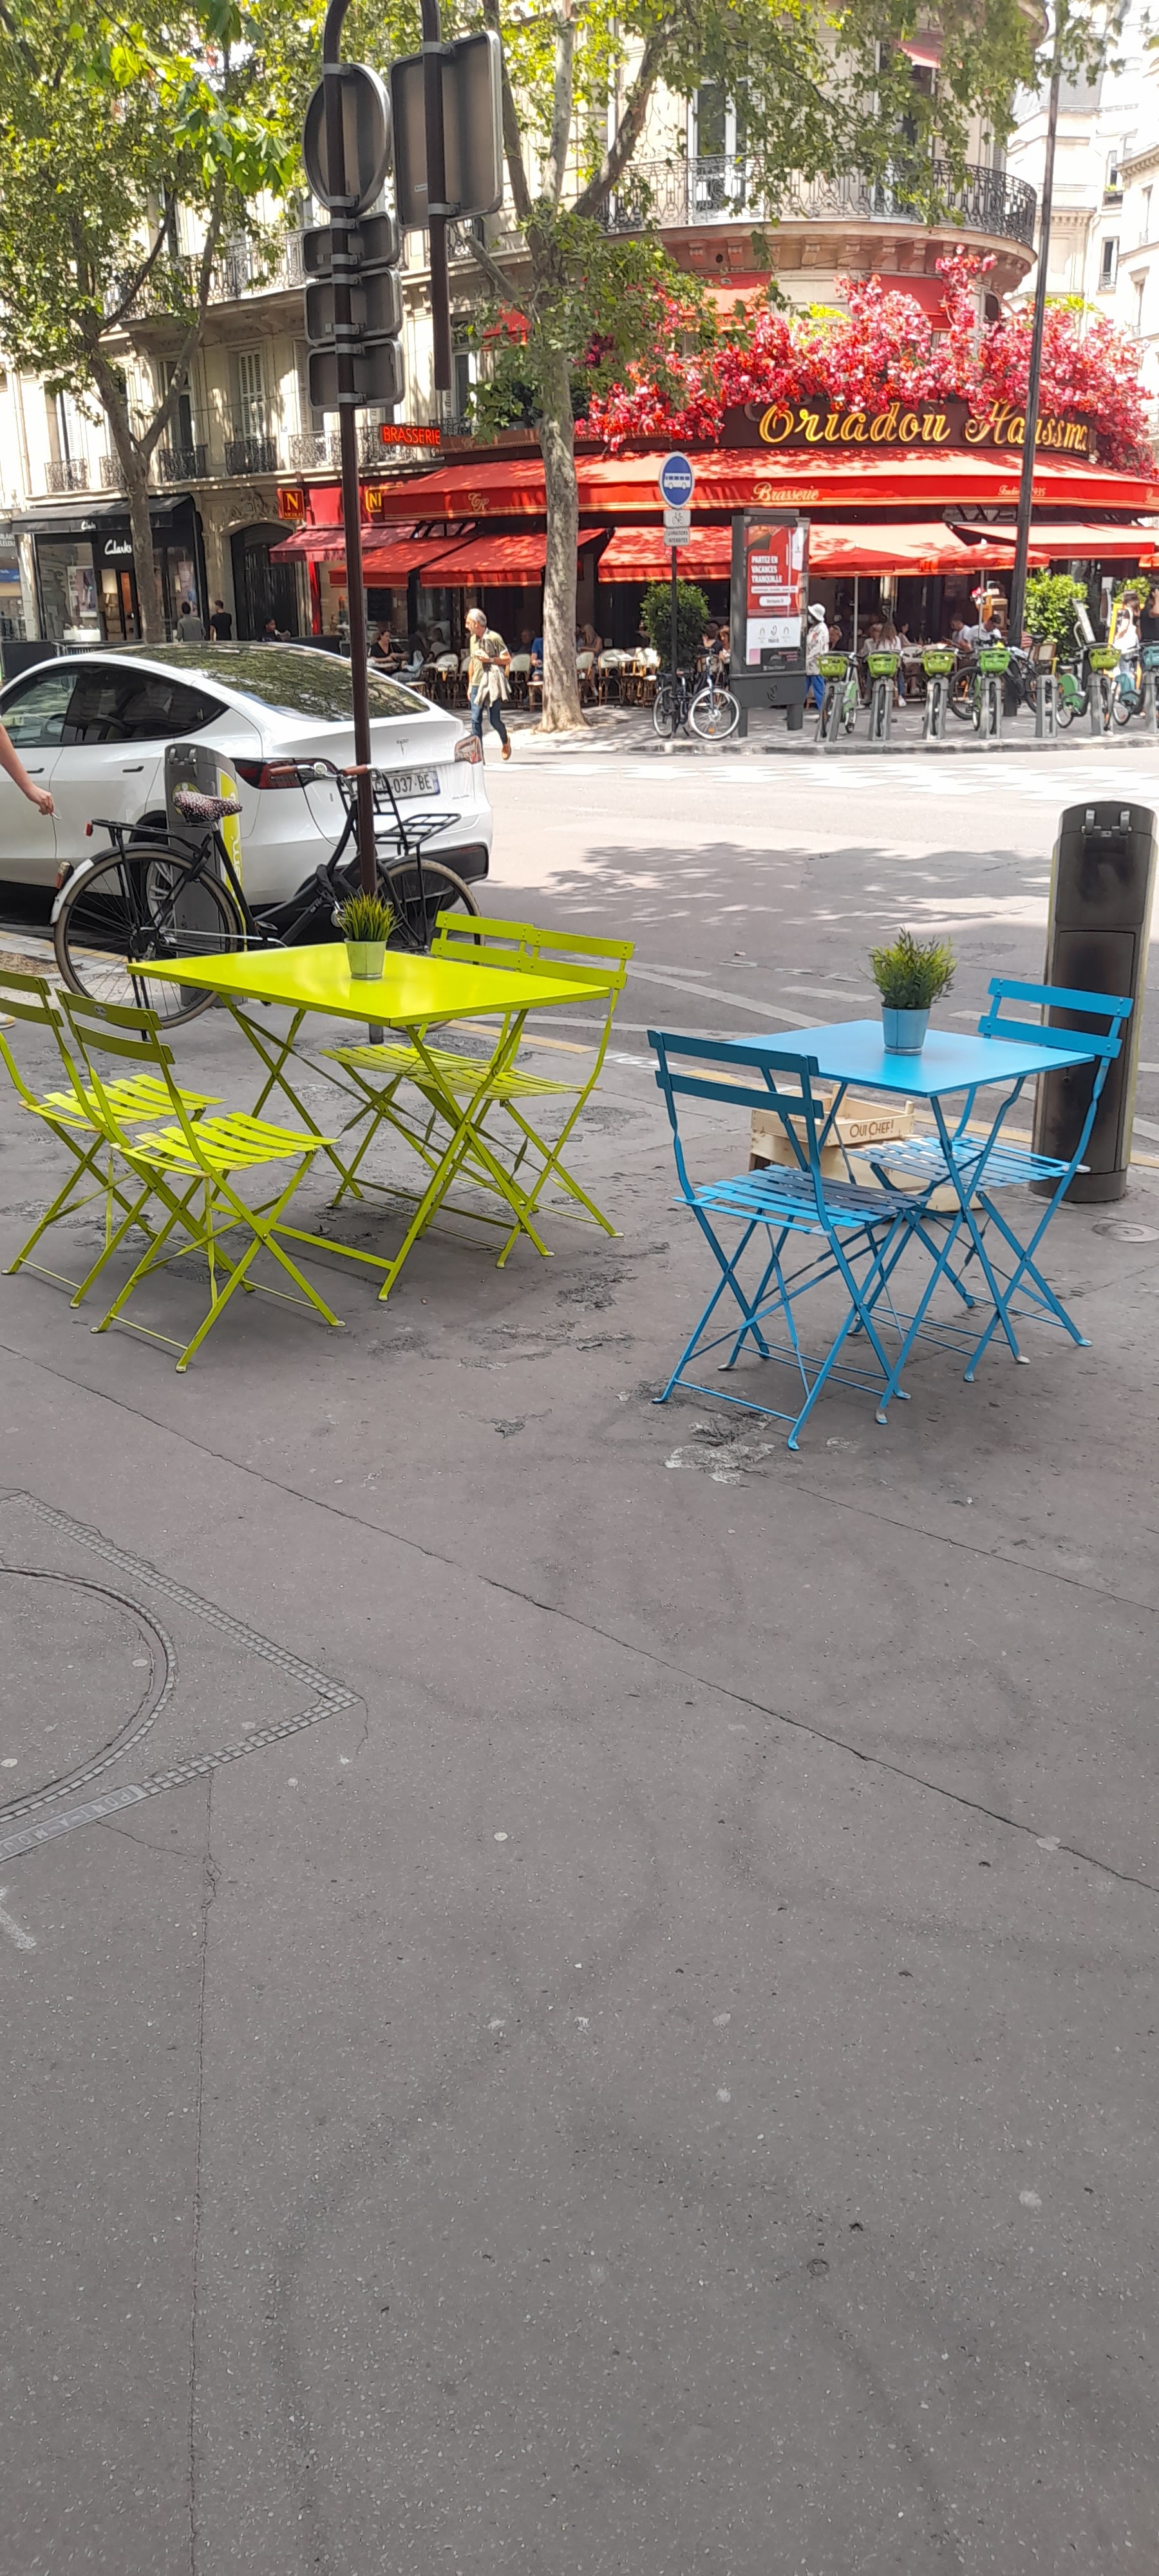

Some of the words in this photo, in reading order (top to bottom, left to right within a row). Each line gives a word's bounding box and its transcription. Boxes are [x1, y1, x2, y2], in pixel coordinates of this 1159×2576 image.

[383, 426, 440, 445] BRASSERIE
[750, 481, 819, 501] Brasserie
[285, 493, 299, 510] N
[104, 539, 132, 555] Clarks
[850, 1124, 867, 1138] OUI
[869, 1119, 894, 1136] CHEF!
